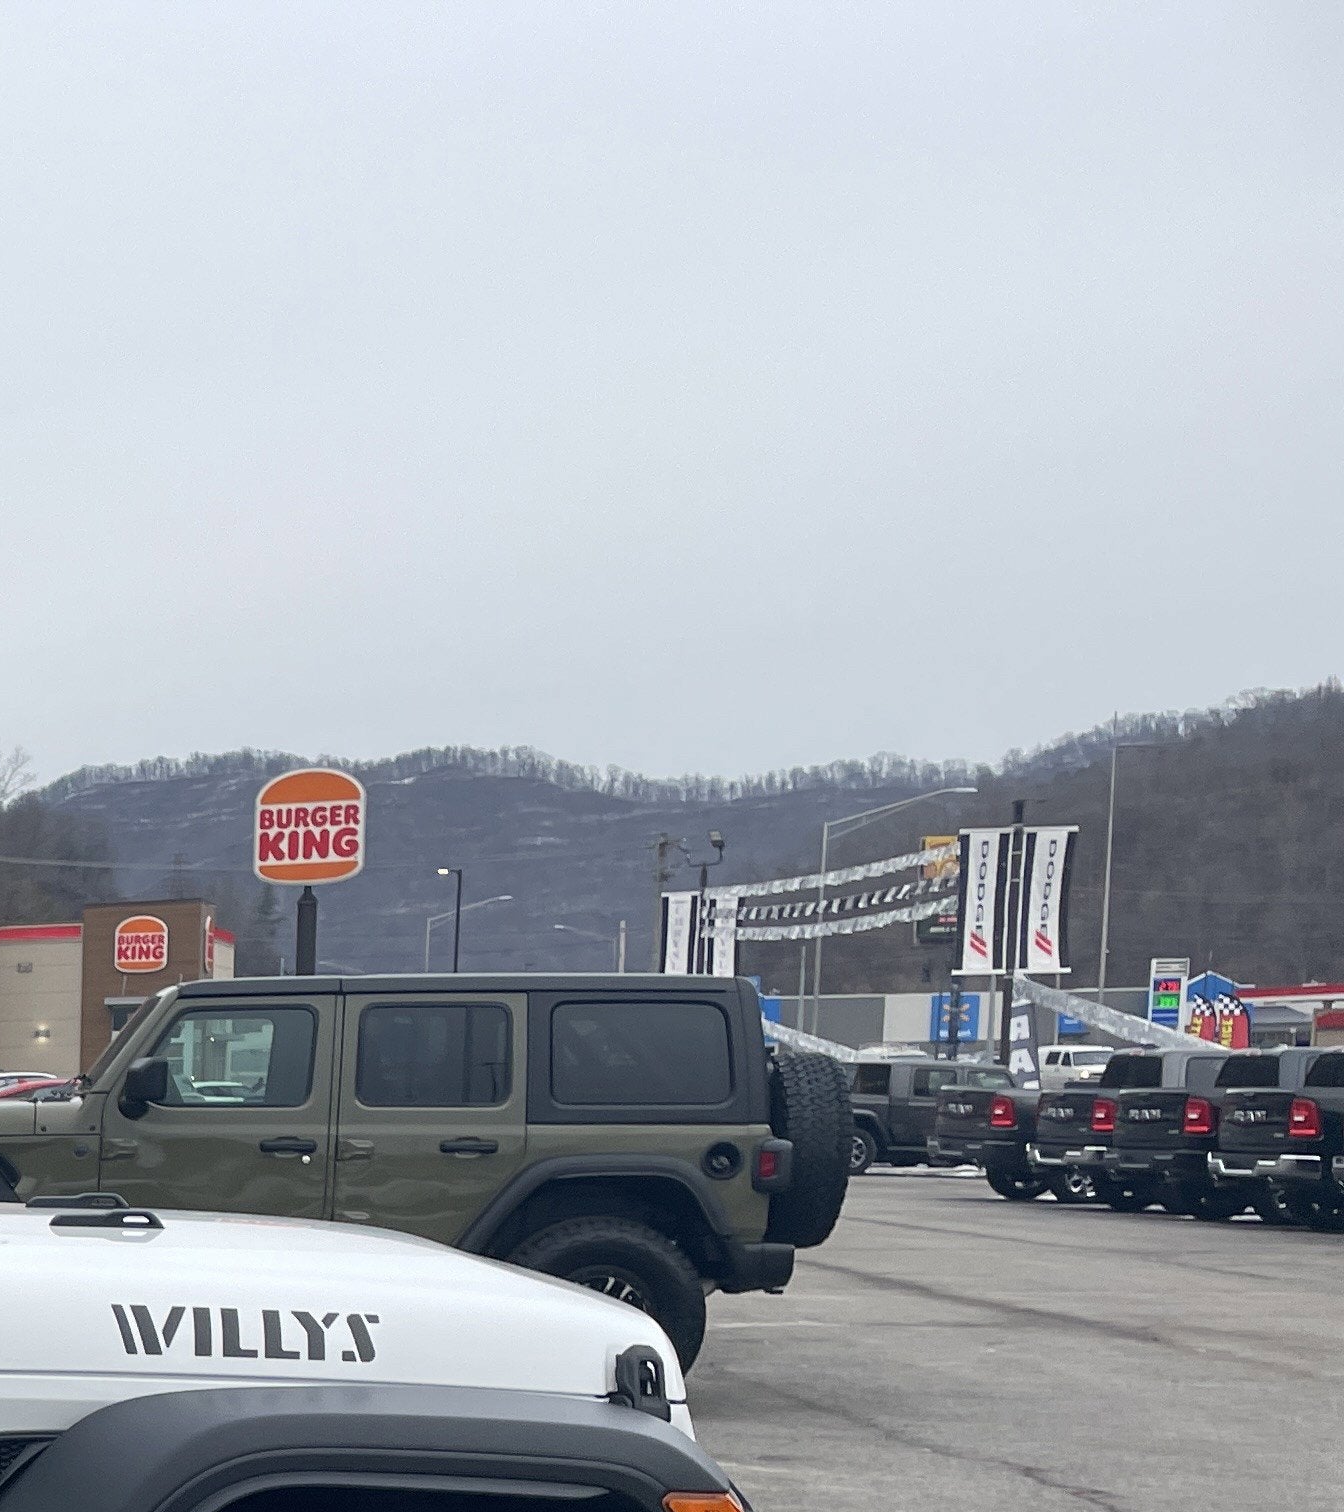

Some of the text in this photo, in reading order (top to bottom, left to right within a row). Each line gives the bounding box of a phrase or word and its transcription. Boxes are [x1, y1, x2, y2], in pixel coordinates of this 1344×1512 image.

[259, 804, 360, 830] BURGER
[259, 827, 359, 862] KING
[975, 840, 989, 941] DODGE
[1039, 839, 1057, 940] DODGE
[117, 934, 165, 946] BURGER
[117, 945, 165, 960] KING
[111, 1303, 380, 1363] WILLYS
